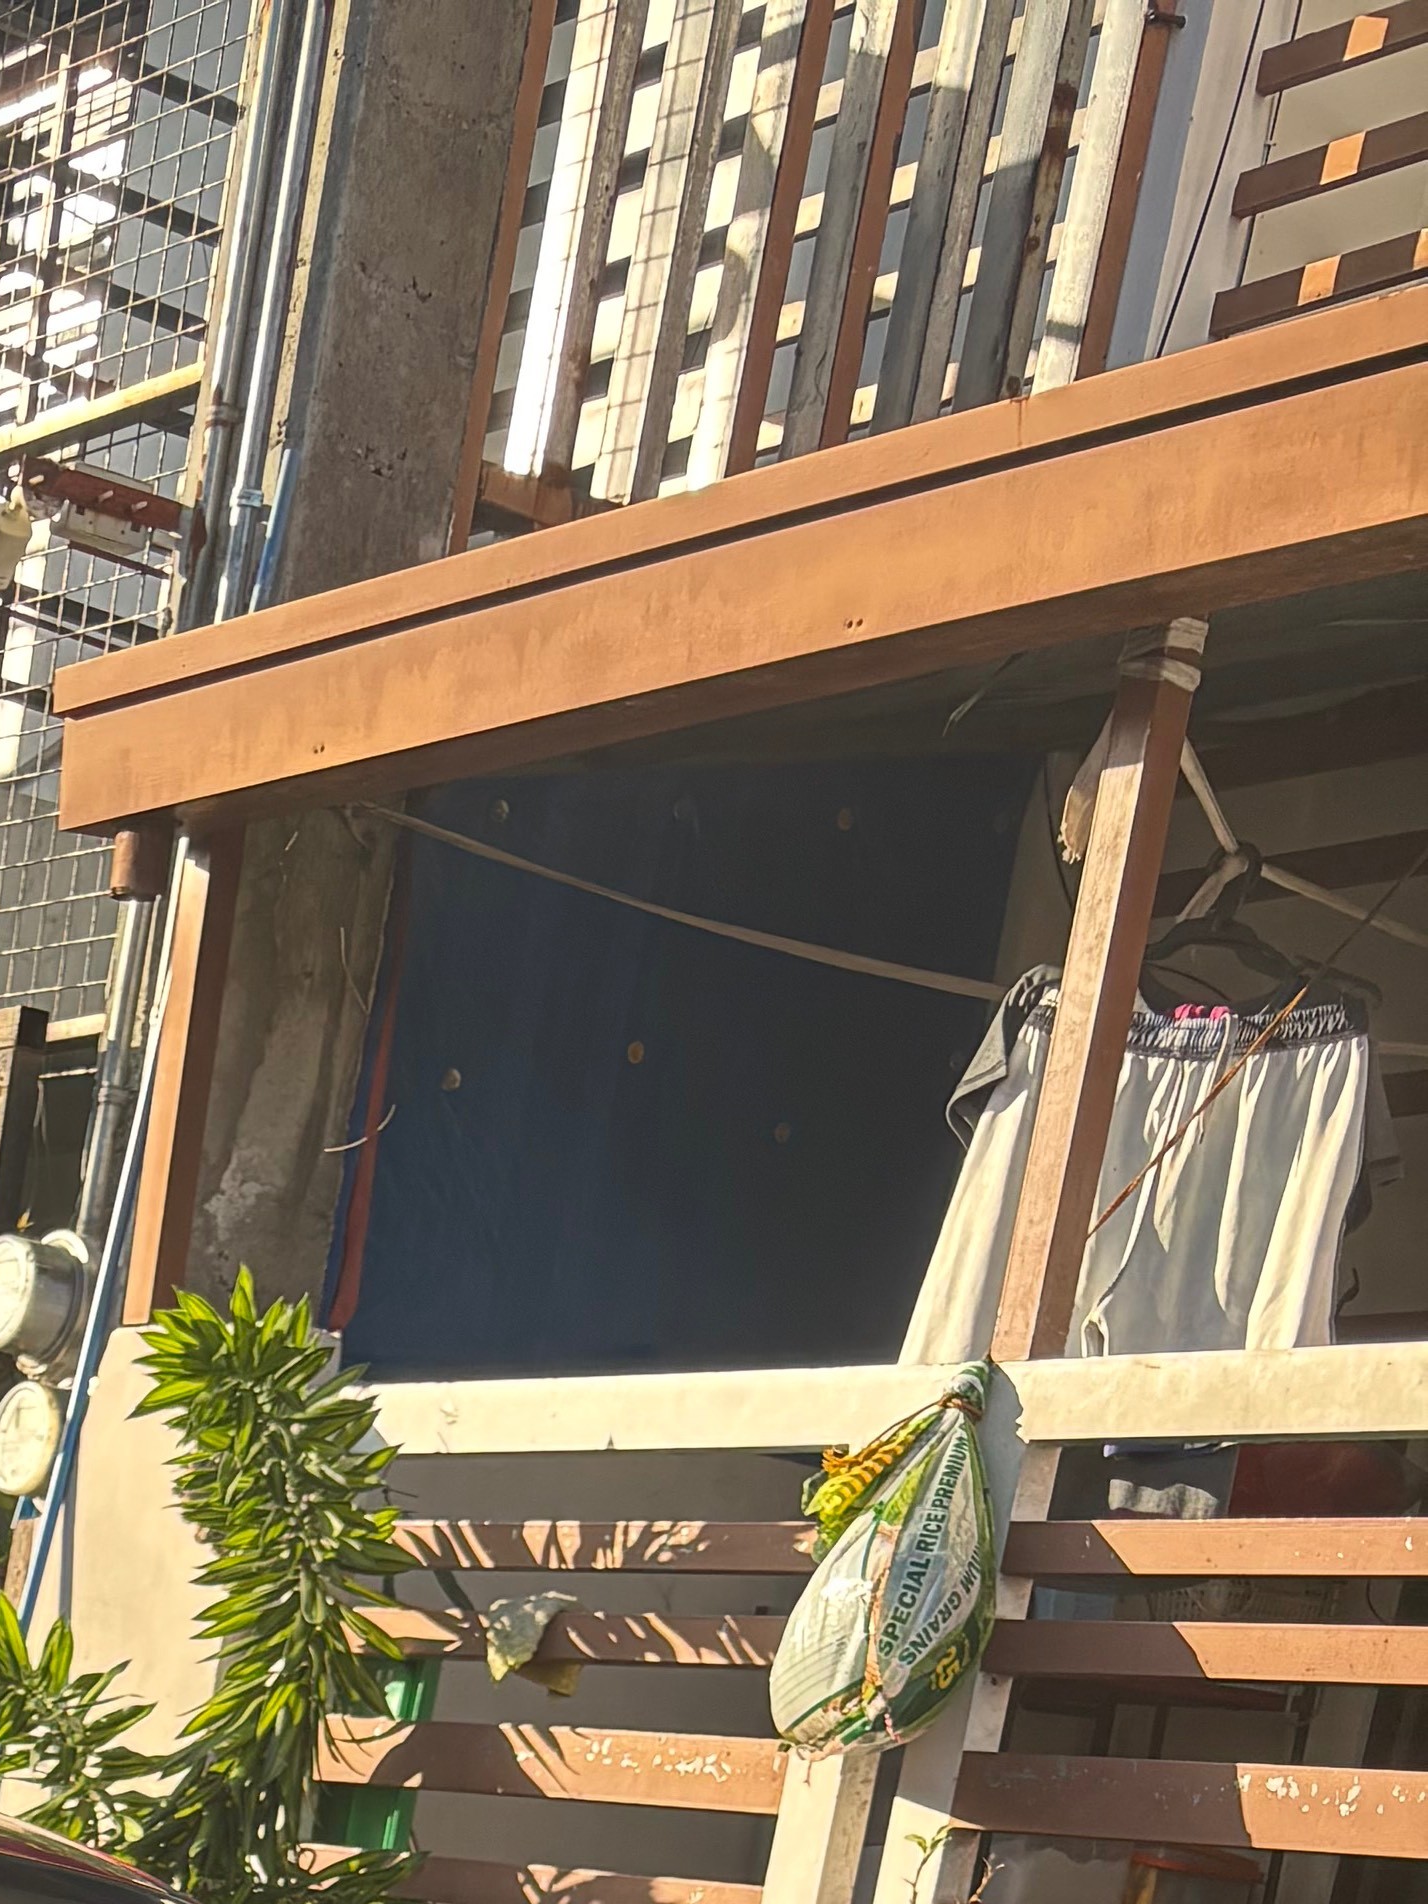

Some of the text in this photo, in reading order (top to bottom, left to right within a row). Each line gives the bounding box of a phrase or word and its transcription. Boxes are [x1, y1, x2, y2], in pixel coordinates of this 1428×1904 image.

[878, 1435, 968, 1657] SPECIAL RICE PREMIUM
[898, 1589, 962, 1666] GRAINS
